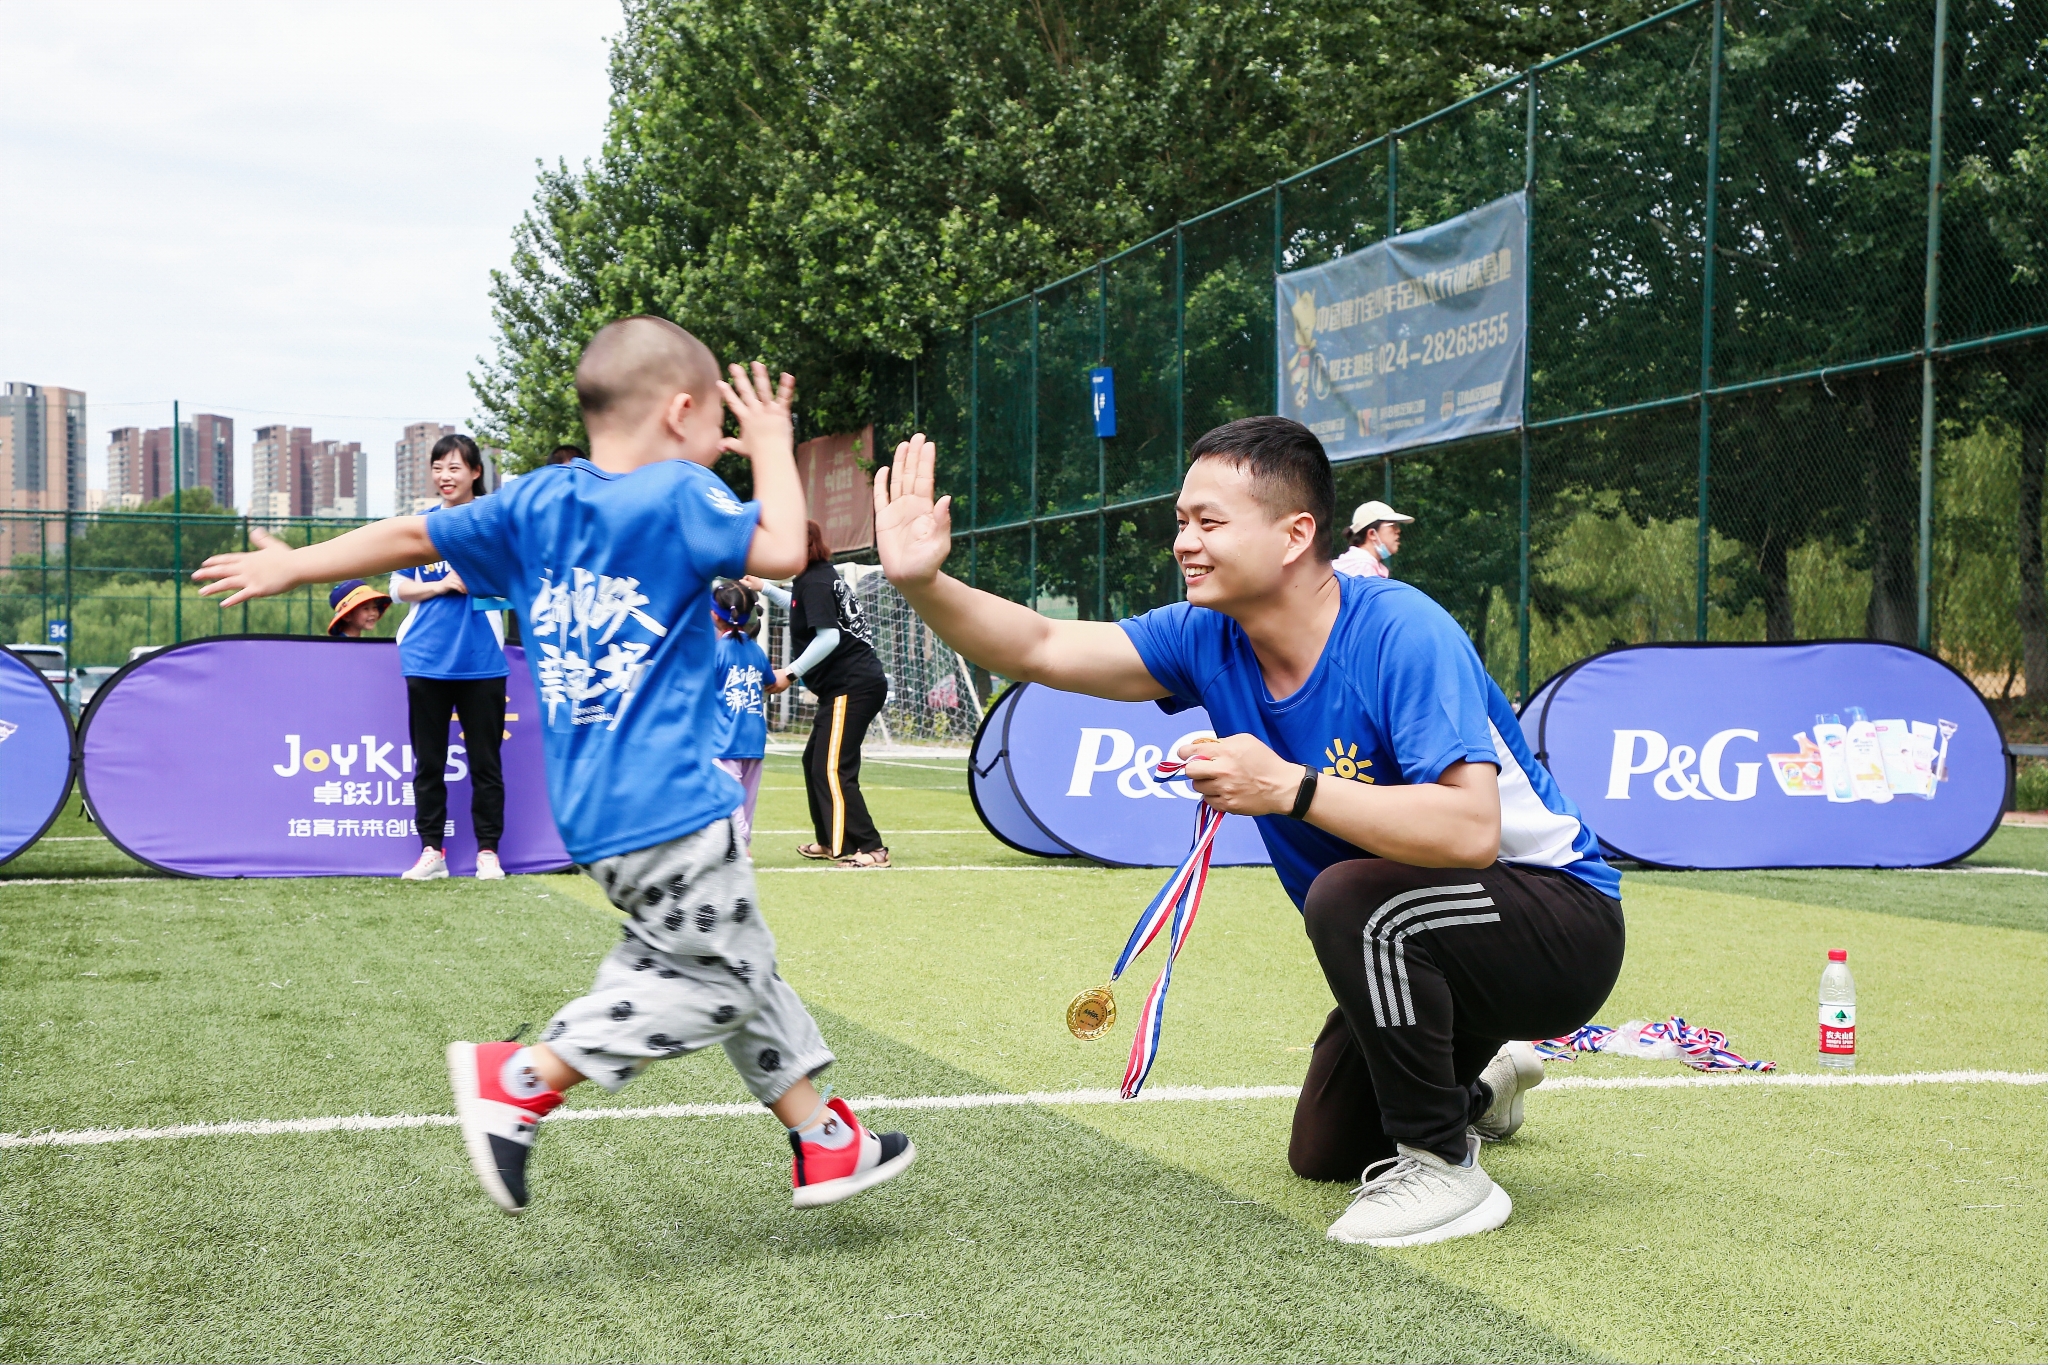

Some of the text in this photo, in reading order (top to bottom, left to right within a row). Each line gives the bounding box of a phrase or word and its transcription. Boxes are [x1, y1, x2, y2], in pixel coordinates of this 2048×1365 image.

[1378, 312, 1509, 375] 024-28265555
[273, 734, 468, 782] JoyKis
[1605, 728, 1763, 801] P&G
